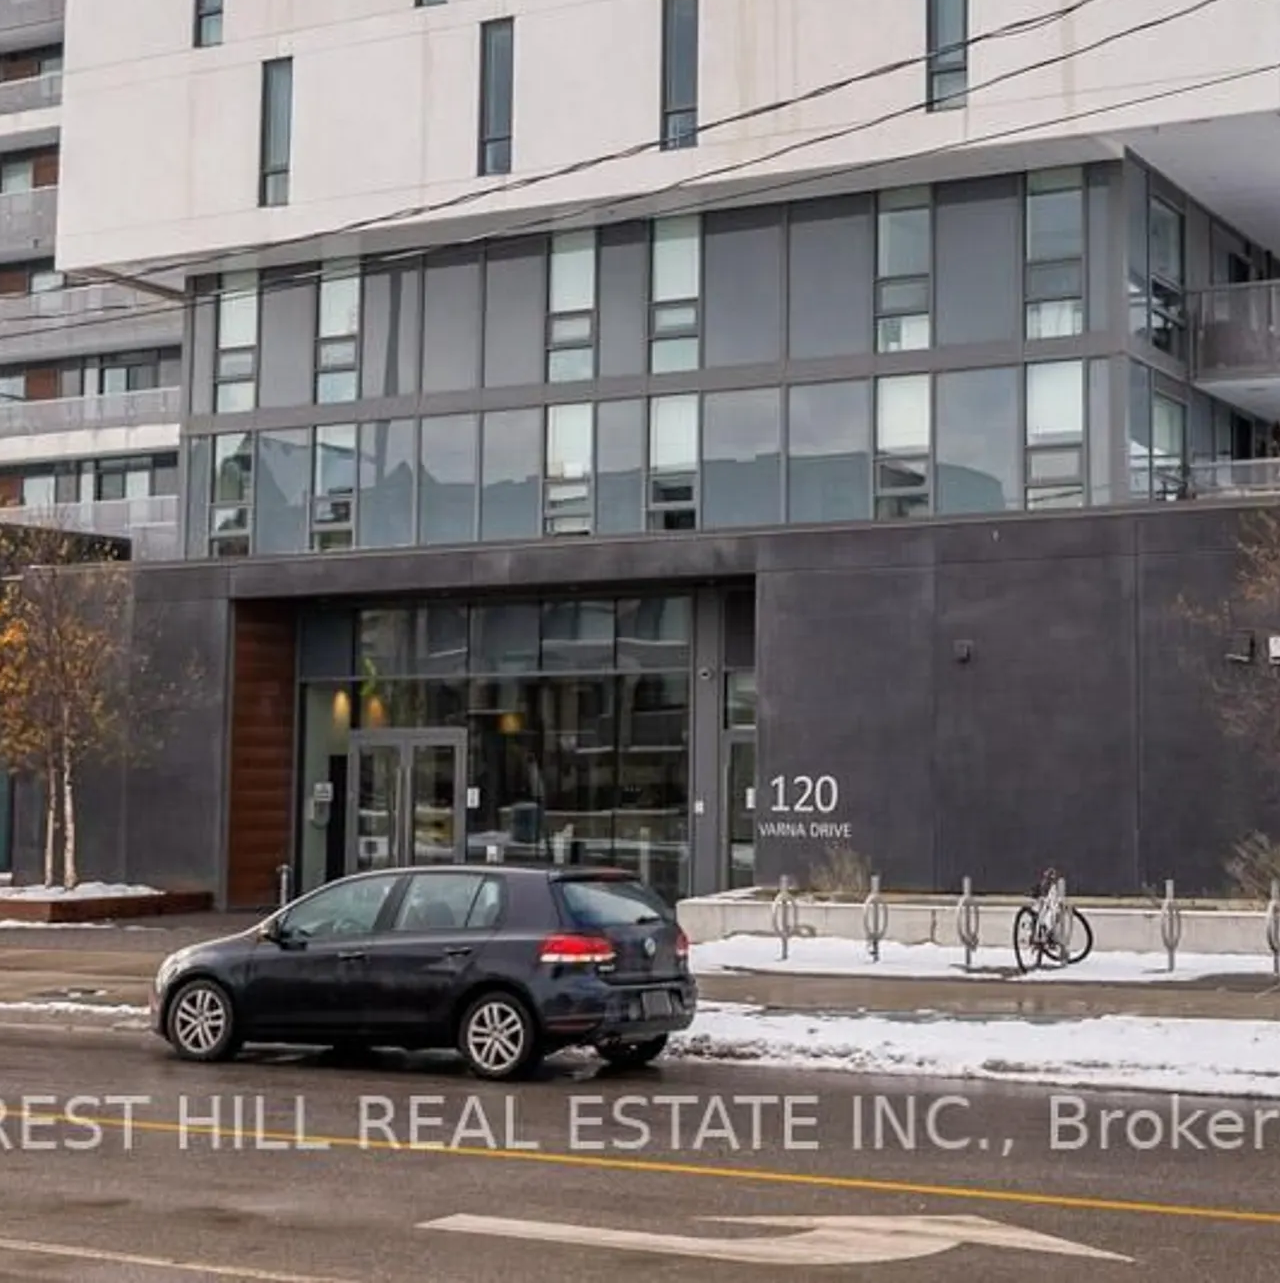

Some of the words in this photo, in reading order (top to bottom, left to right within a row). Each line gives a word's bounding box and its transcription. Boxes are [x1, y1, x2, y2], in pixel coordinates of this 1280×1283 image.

[770, 775, 838, 813] 120
[758, 821, 807, 837] VARNA
[810, 821, 852, 838] DRIVE
